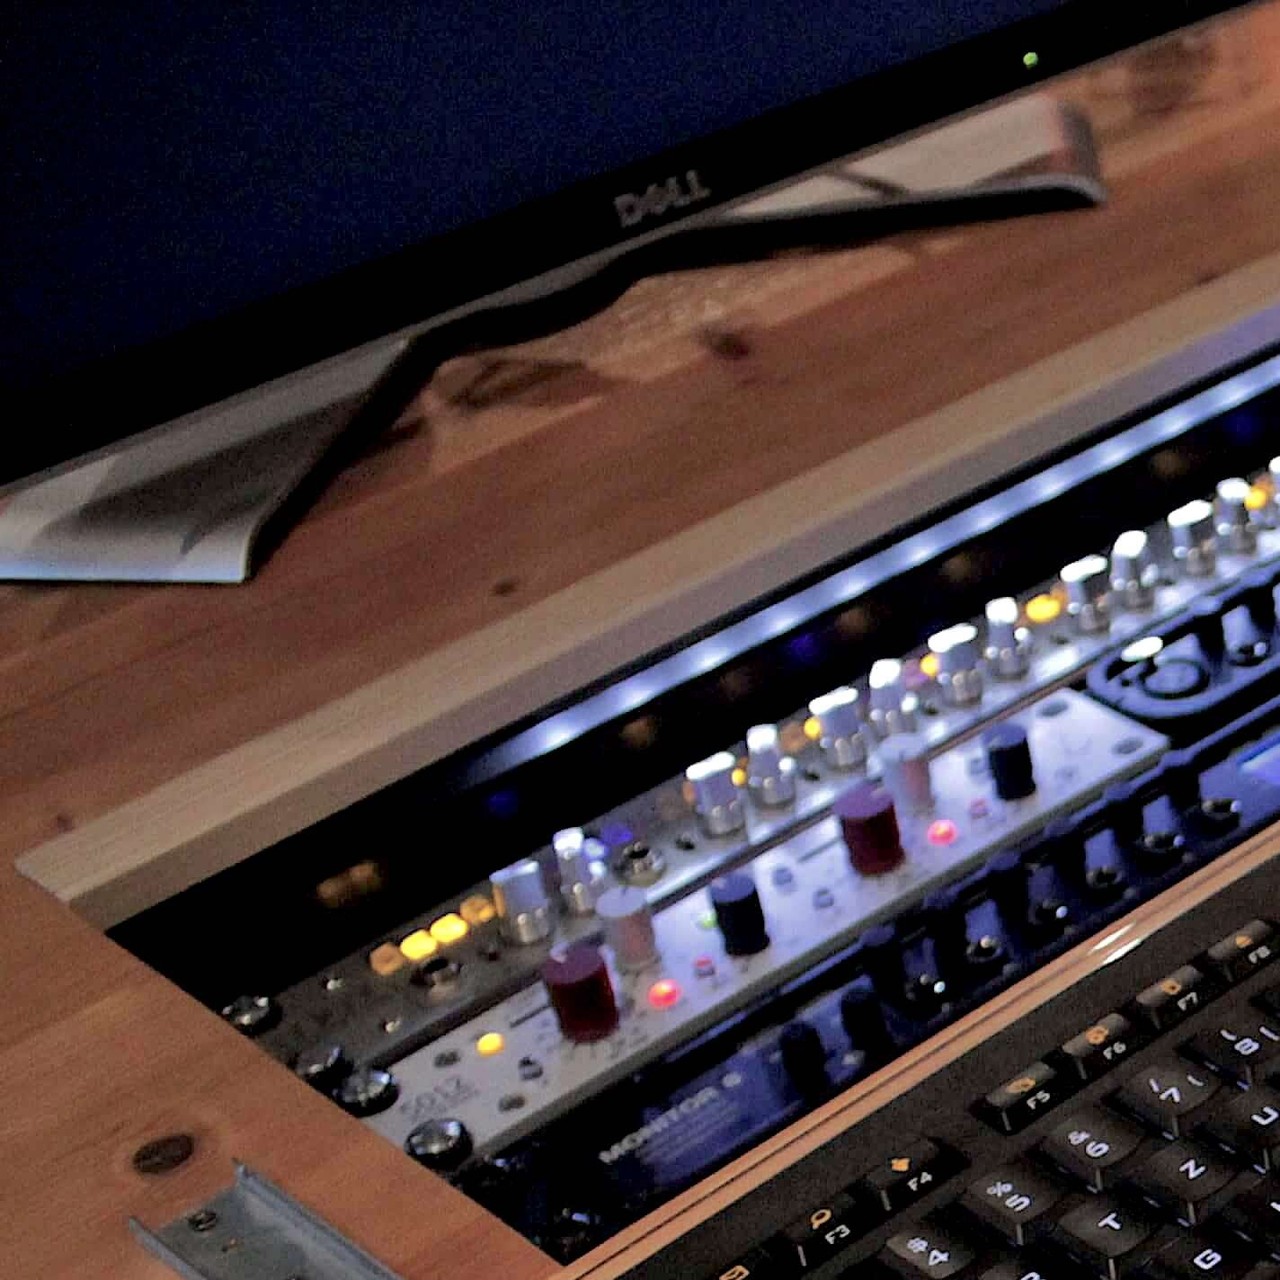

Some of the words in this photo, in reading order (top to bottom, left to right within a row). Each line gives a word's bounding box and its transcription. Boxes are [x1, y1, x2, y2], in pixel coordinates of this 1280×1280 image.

[1103, 1042, 1126, 1059] F6
[1235, 1038, 1259, 1054] 8
[1160, 1087, 1180, 1102] 7
[1252, 1107, 1278, 1125] U
[1086, 1142, 1109, 1156] 6
[1180, 1160, 1205, 1178] Z
[908, 1172, 932, 1191] F4
[1005, 1195, 1029, 1211] 5
[1098, 1214, 1120, 1229] T
[825, 1225, 850, 1244] F3
[929, 1250, 948, 1265] 4
[1194, 1249, 1221, 1269] G
